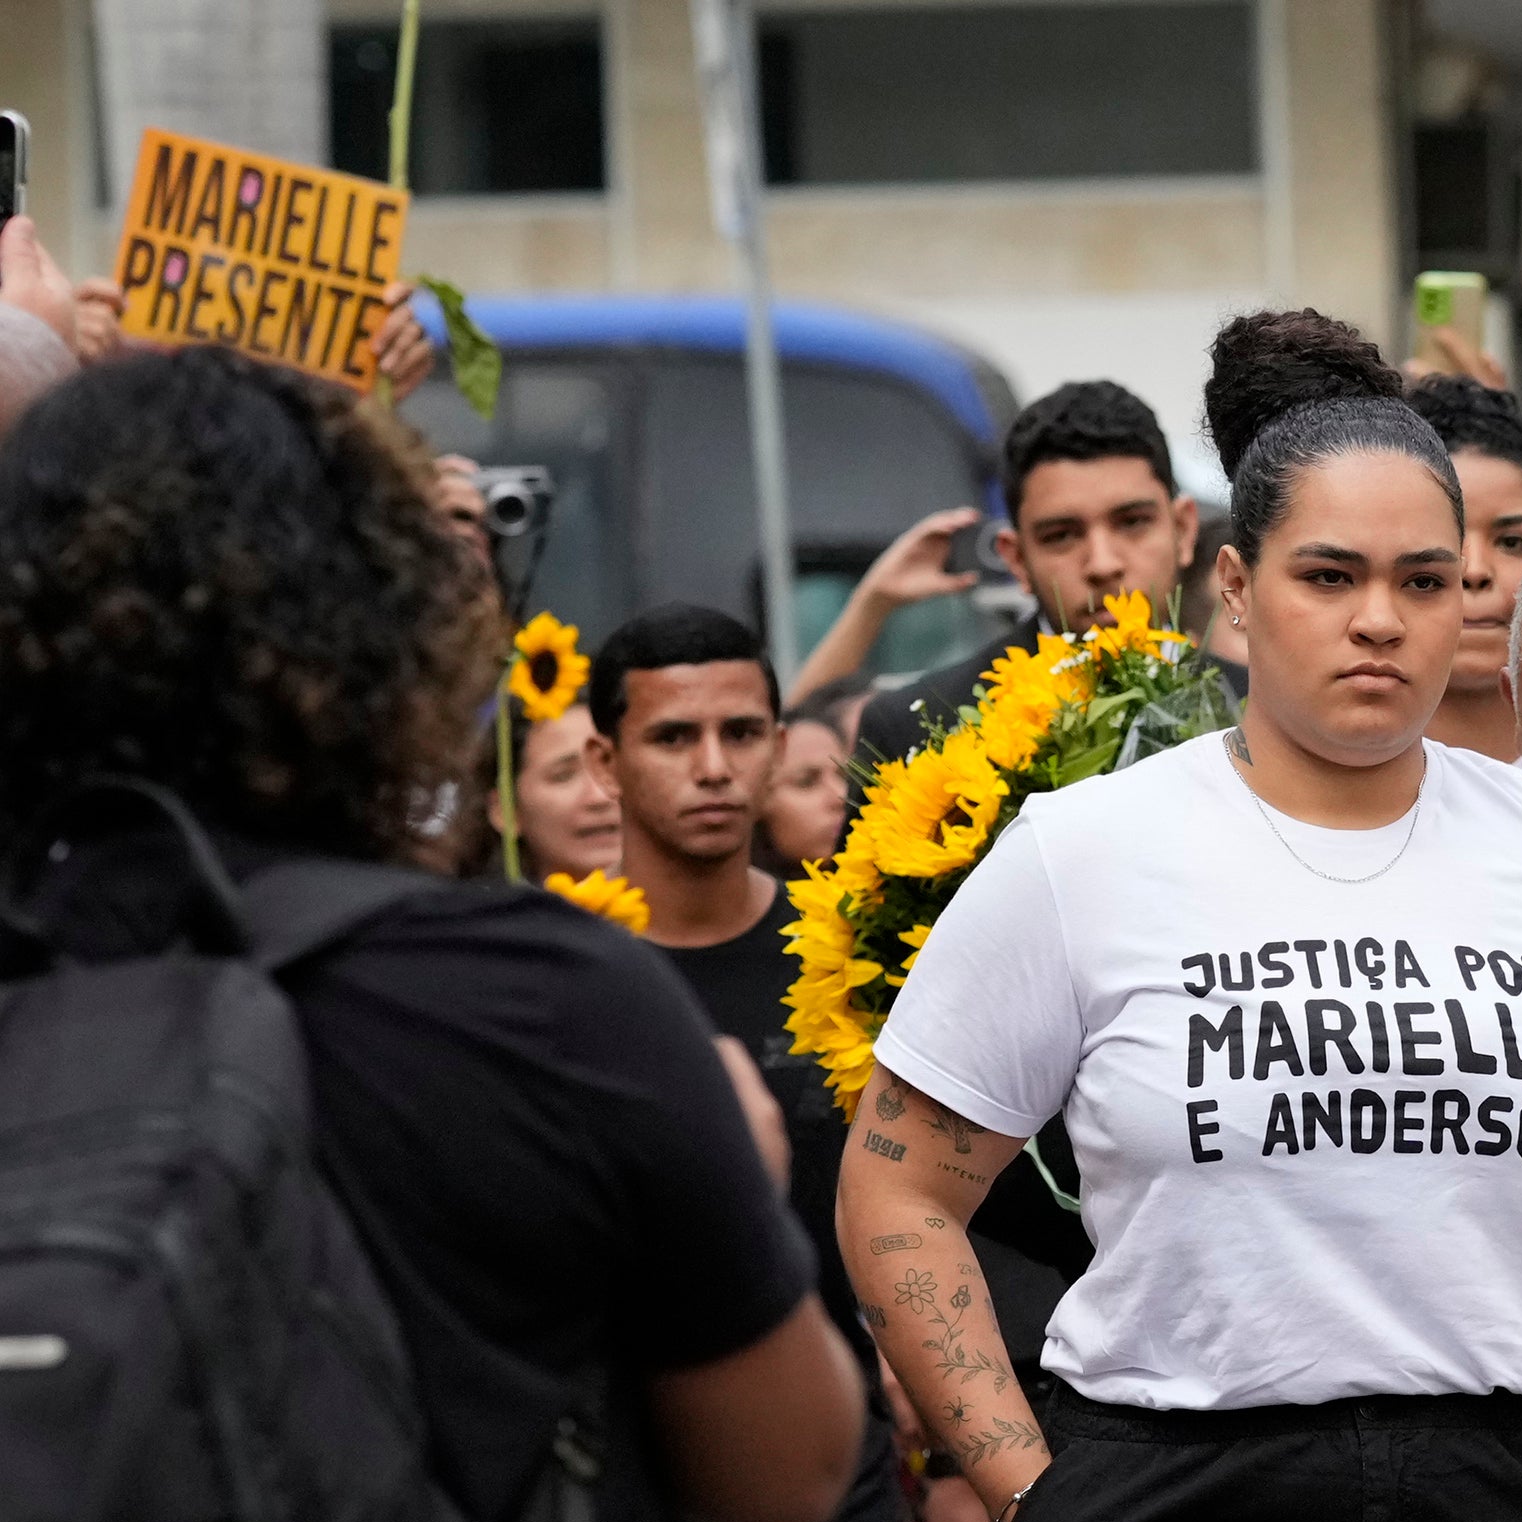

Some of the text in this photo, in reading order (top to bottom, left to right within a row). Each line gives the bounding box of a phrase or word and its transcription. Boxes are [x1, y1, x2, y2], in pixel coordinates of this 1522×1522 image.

[144, 145, 398, 285] MARIELLE
[122, 236, 387, 377] PRESENTE
[1181, 936, 1431, 999] JUSTIÇA
[1186, 1099, 1224, 1164] E
